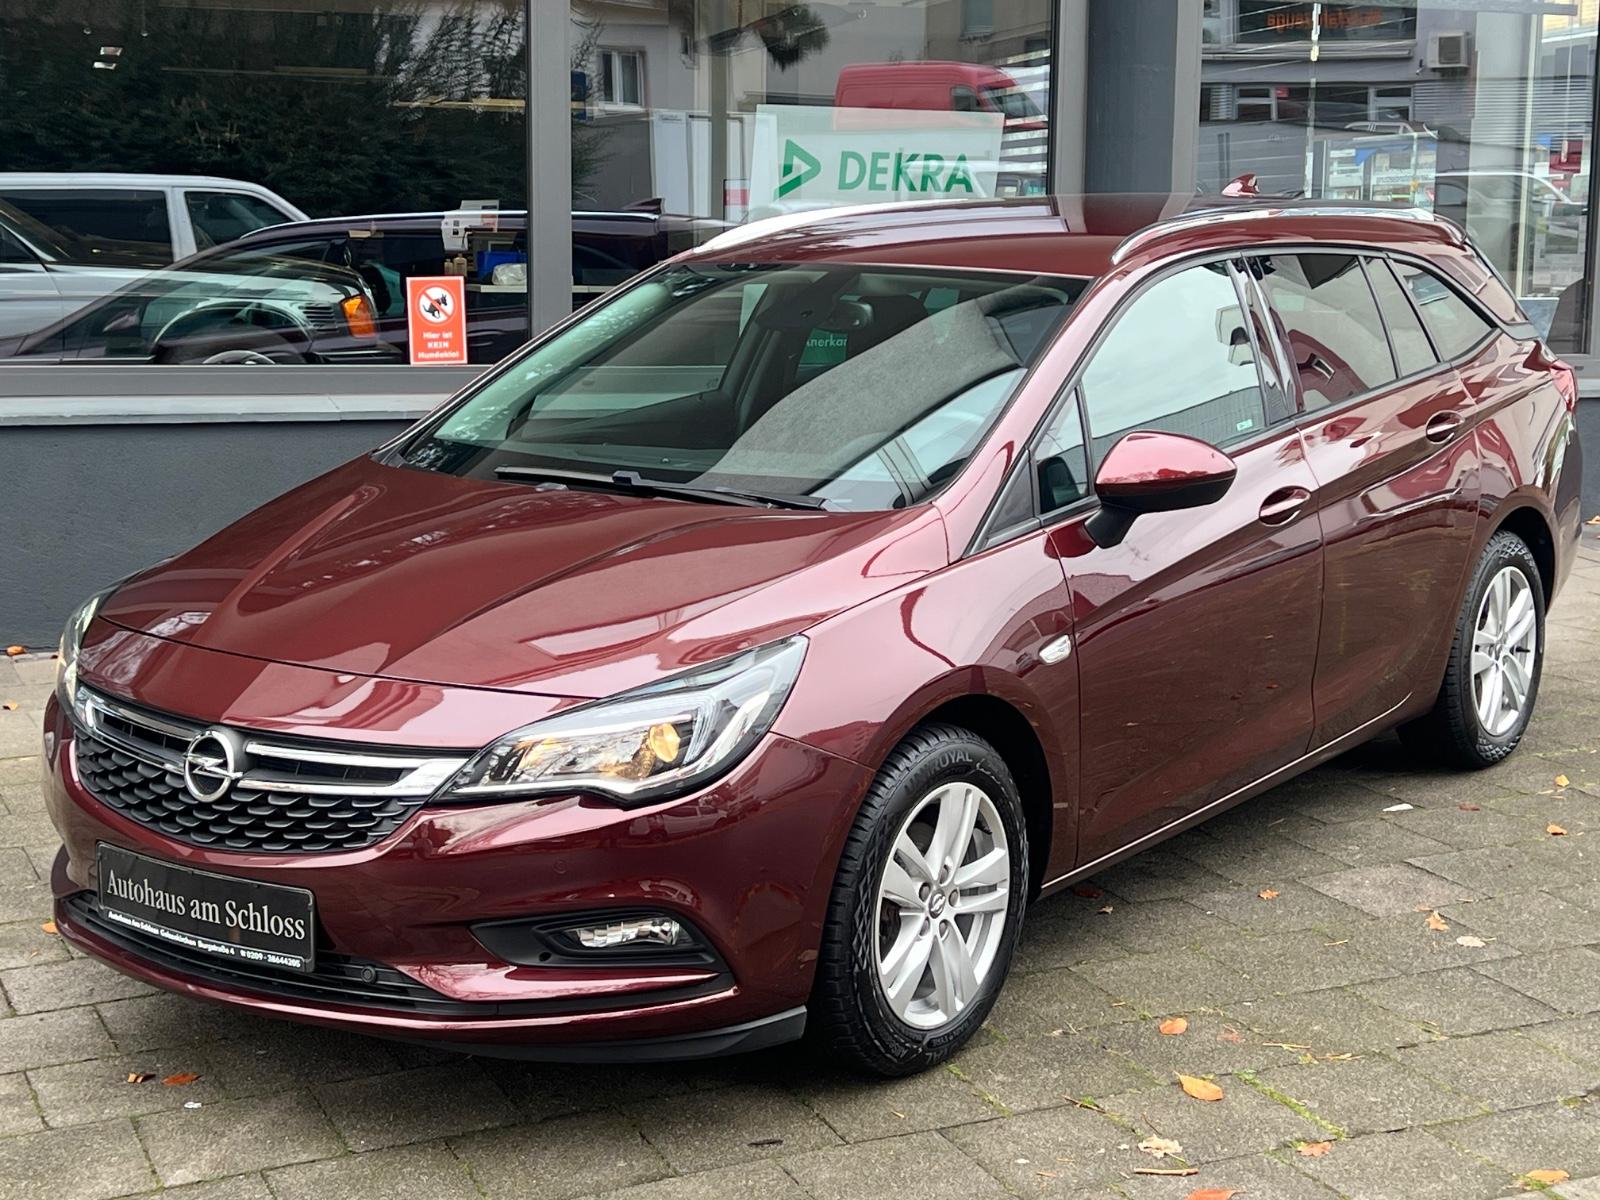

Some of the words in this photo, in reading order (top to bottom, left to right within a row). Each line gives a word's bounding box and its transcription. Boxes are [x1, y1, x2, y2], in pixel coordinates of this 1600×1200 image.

[838, 150, 973, 193] DEKRA
[422, 331, 440, 339] Hier
[442, 331, 453, 339] ist
[427, 341, 449, 349] KEIN
[106, 869, 186, 916] Autohaus
[190, 899, 221, 925] am
[225, 900, 305, 940] Schloss
